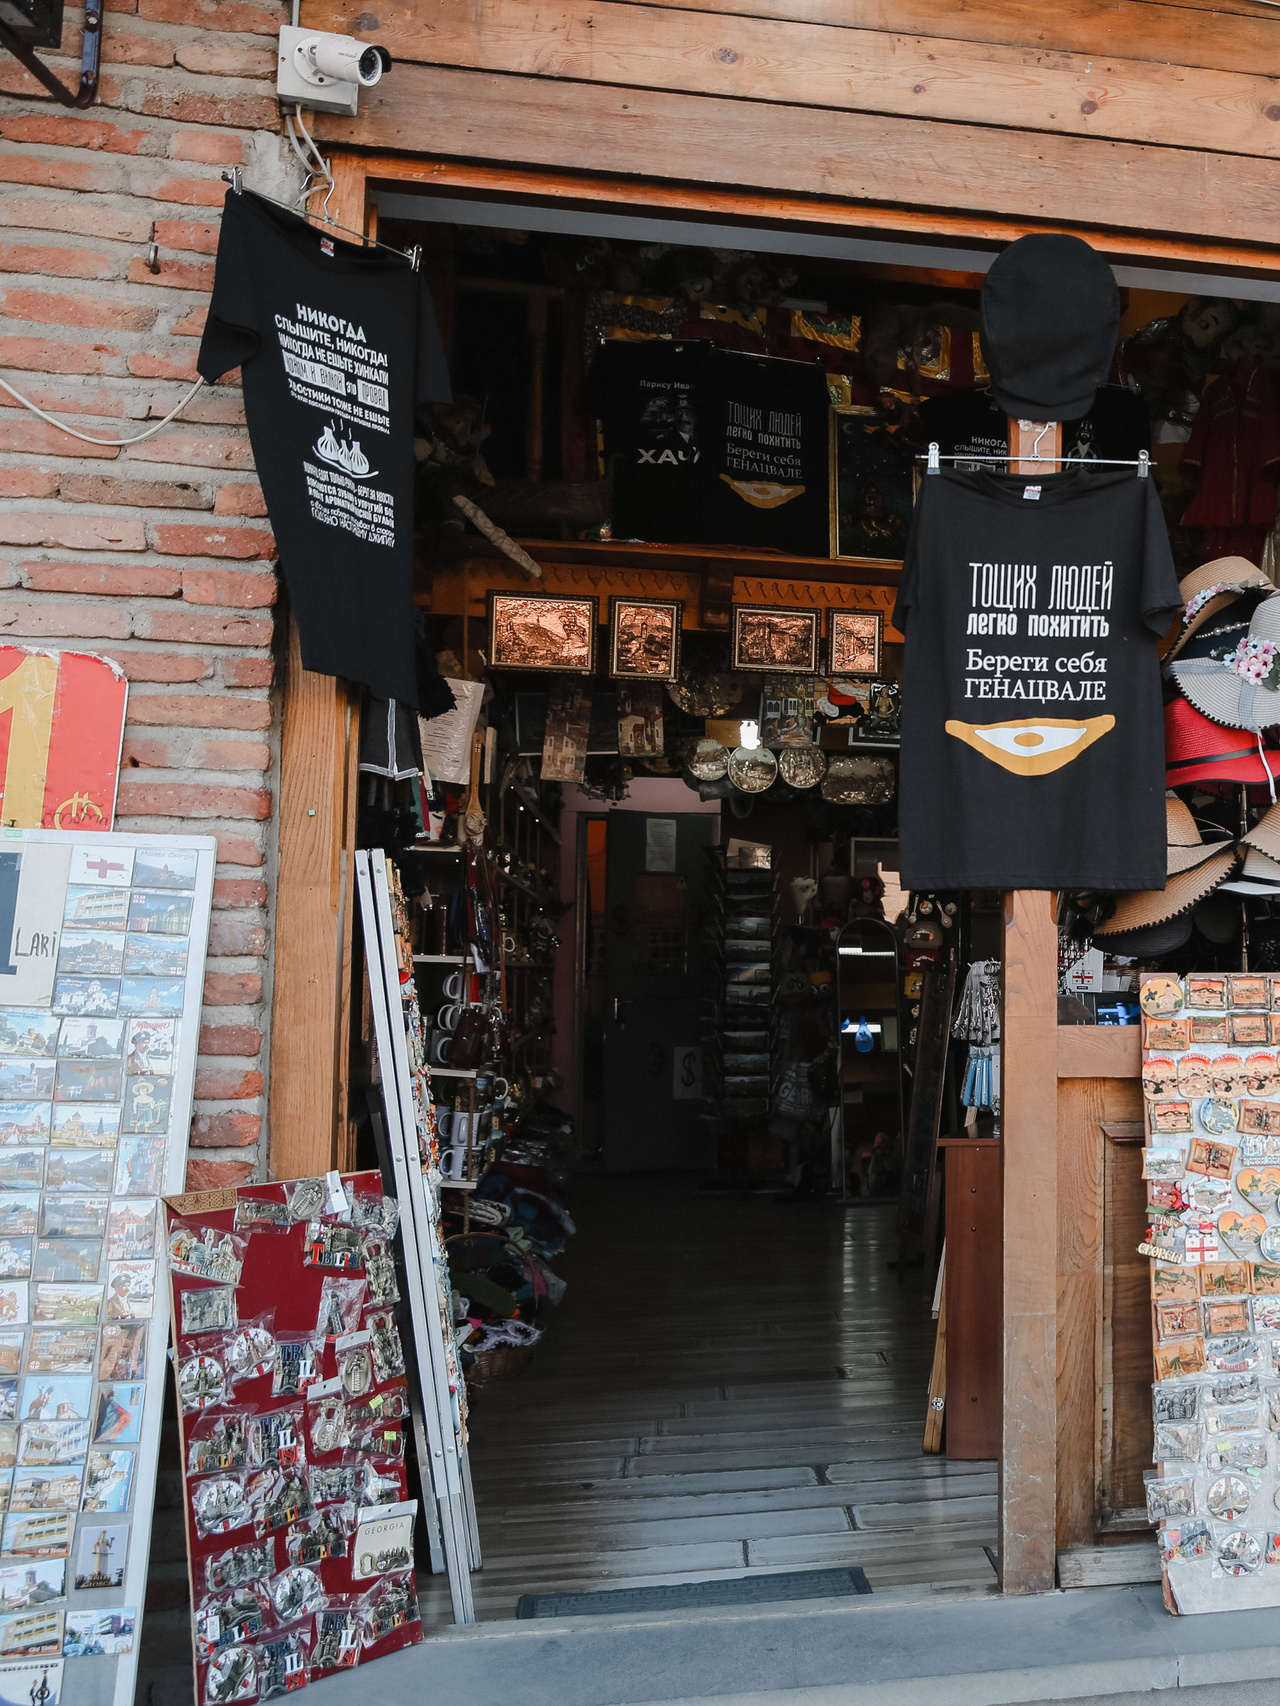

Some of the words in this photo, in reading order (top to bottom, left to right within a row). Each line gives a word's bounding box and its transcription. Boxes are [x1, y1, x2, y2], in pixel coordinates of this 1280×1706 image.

[296, 303, 367, 343] НИКОГДА
[274, 313, 335, 351] СЛЫШИТЕ,
[336, 337, 388, 367] НИКОГДА!
[278, 331, 315, 360] НИКОГДА
[315, 346, 327, 363] НЕ
[326, 350, 354, 373] ЕШЬТЕ
[354, 360, 389, 387] ХИНКАЛИ
[331, 396, 353, 414] ТОЖЕ
[353, 405, 364, 418] НЕ
[364, 409, 390, 428] ЕШЬТЕ
[727, 400, 762, 430] ТОЩИХ
[768, 411, 802, 437] ЛЮДЕЙ
[727, 442, 770, 462] Береги
[773, 453, 801, 466] себя
[954, 445, 992, 456] СЛЫШИТЕ,
[727, 456, 803, 480] ГЕНАЦВАЛЕ
[969, 562, 1037, 612] ТОЩИХ
[1048, 561, 1113, 613] ЛЮДЕЙ
[965, 648, 1049, 678] Береги
[1055, 651, 1107, 673] себя
[964, 678, 1106, 705] ГЕНАЦВАЛЕ
[1139, 1243, 1183, 1264] GEORGIA
[364, 1522, 405, 1536] GEORGIA
[339, 1629, 358, 1648] IL
[284, 1652, 305, 1674] IL
